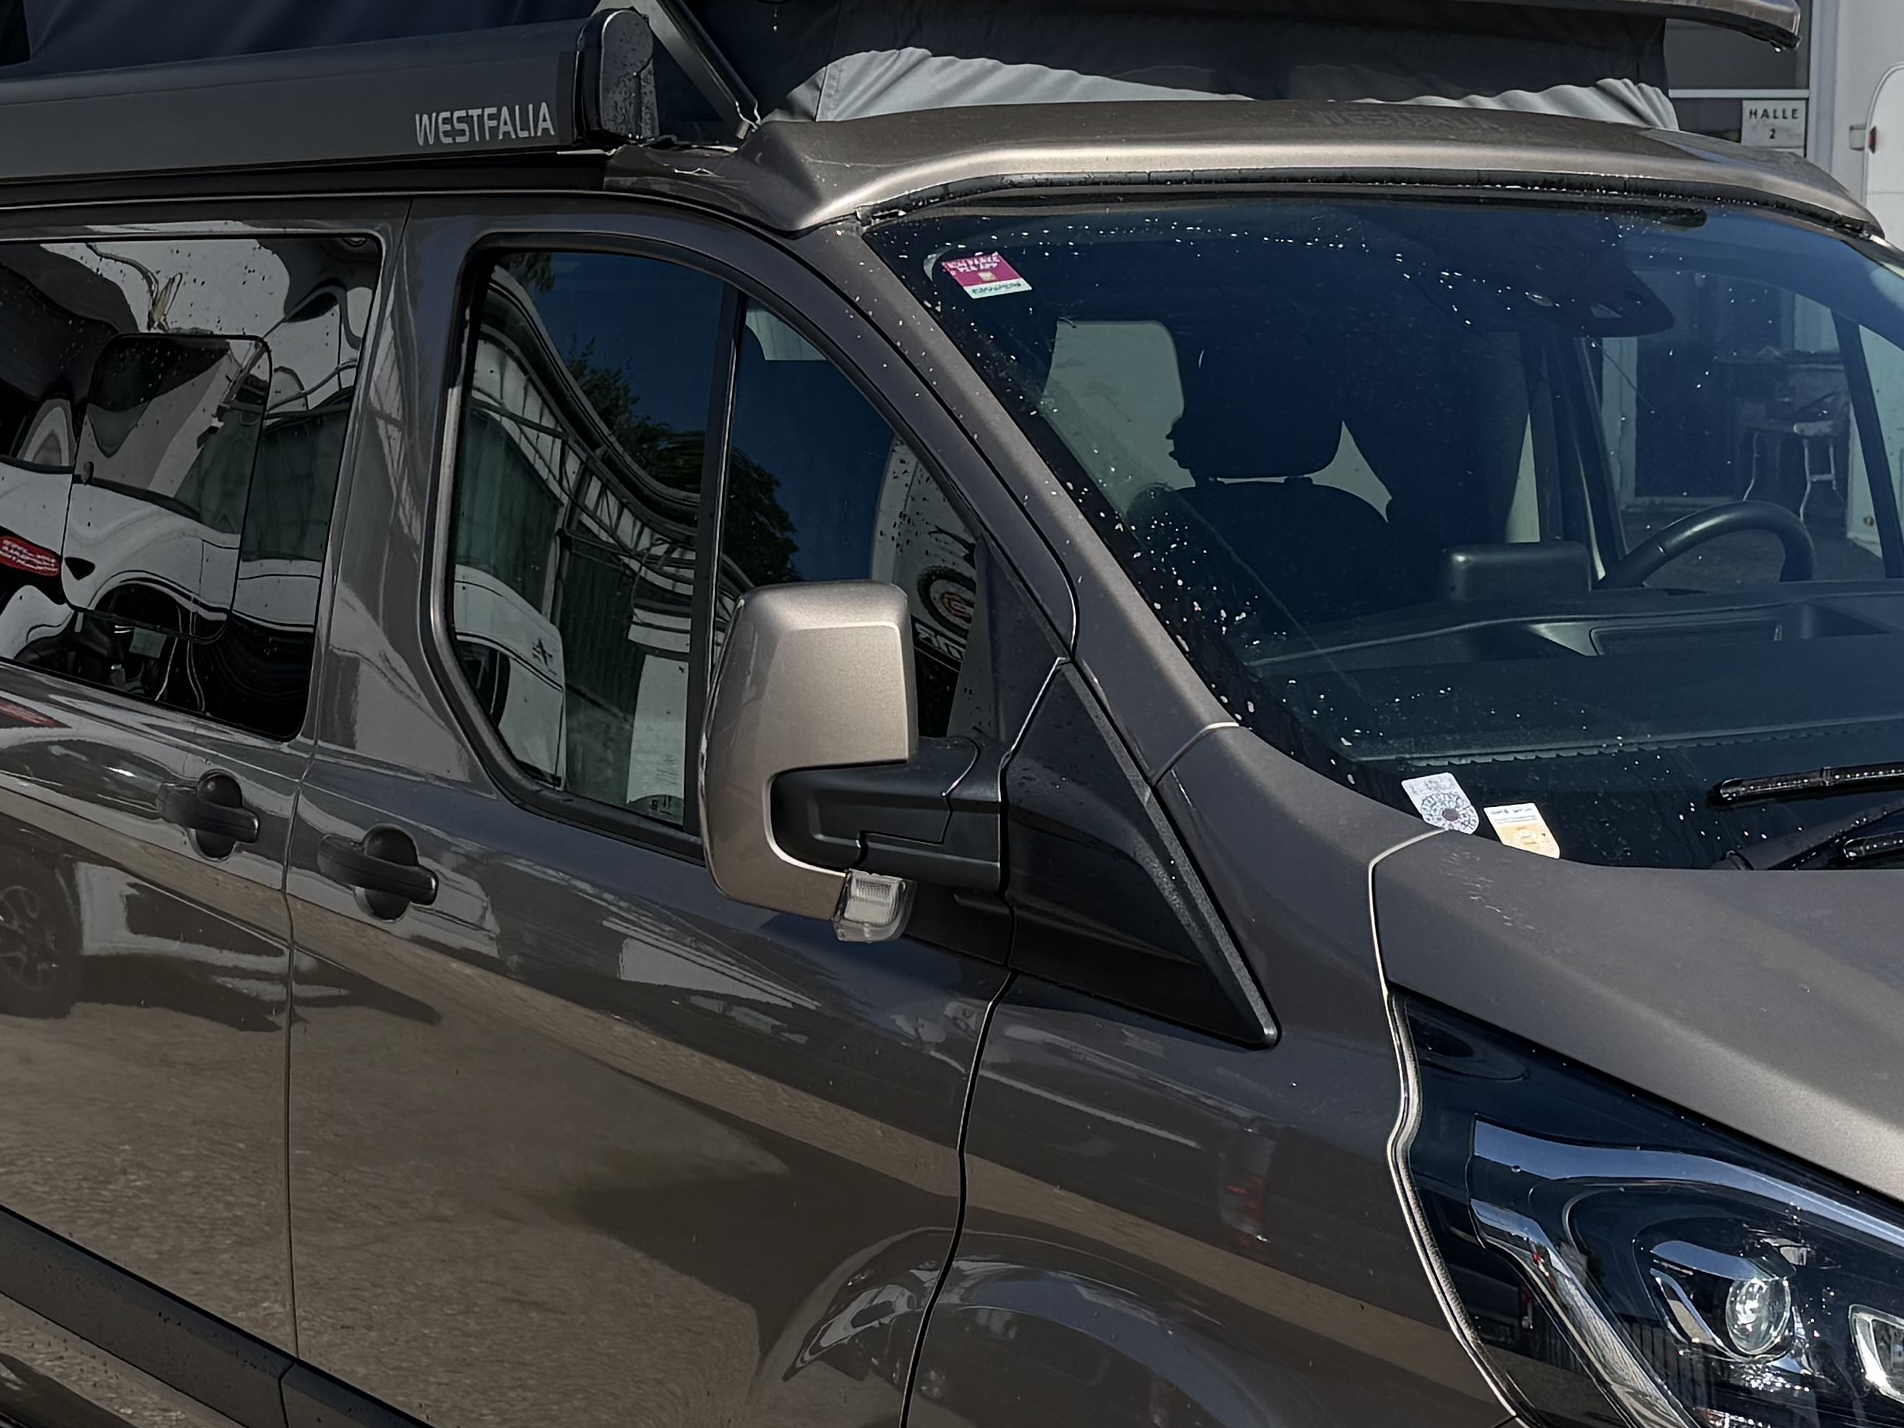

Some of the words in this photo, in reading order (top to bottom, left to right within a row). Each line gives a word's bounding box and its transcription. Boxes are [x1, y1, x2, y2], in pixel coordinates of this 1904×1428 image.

[1748, 108, 1800, 120] HALLE
[414, 101, 556, 147] WESTFALIA
[1768, 128, 1777, 140] 2
